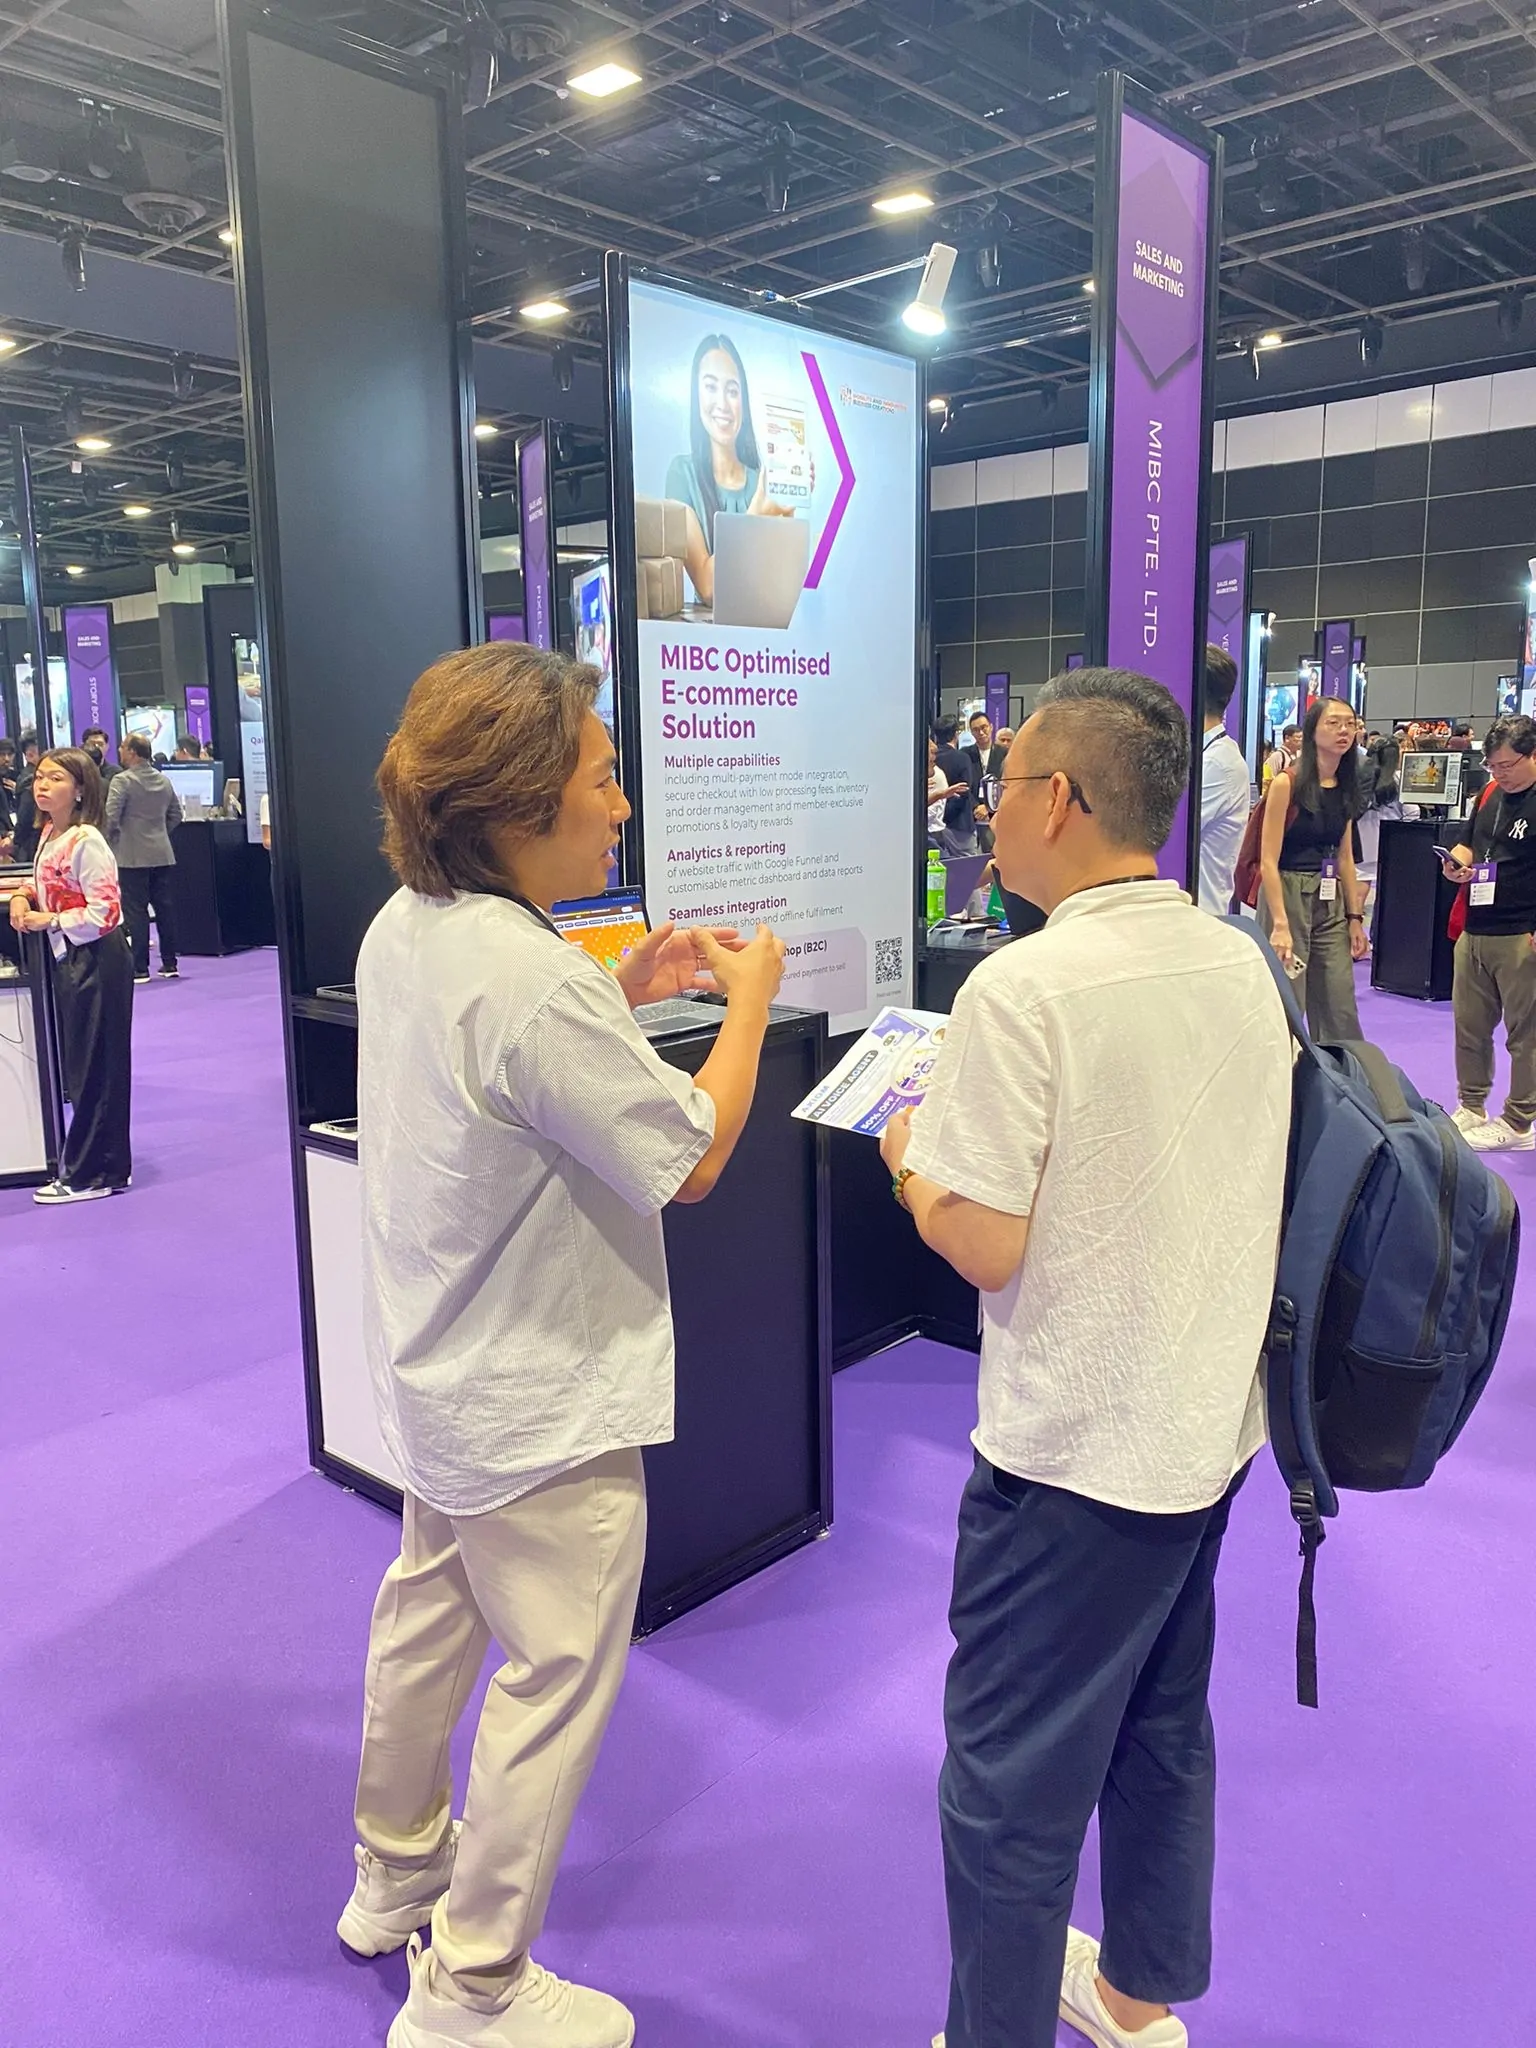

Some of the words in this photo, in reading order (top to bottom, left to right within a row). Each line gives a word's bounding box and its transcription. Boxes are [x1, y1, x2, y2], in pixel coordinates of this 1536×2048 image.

[1135, 240, 1162, 265] SALES
[1163, 254, 1183, 274] AND
[1132, 262, 1184, 297] MARKETING
[1147, 419, 1163, 504] MIBC
[1145, 513, 1160, 578] PTE.
[1143, 590, 1158, 655] LTD.
[661, 644, 719, 672] MIBC
[724, 647, 830, 679] Optimised
[661, 679, 798, 706] E-commerce
[662, 712, 755, 739] Solution
[664, 754, 714, 771] Multiple
[716, 753, 780, 770] capabilities
[664, 773, 710, 786] including
[712, 771, 777, 785] multi-payment
[779, 770, 803, 781] mode
[665, 791, 695, 801] secure
[697, 788, 737, 800] checkout
[739, 787, 758, 798] with
[760, 787, 774, 797] low
[775, 785, 817, 798] processing
[836, 783, 869, 795] inventory
[665, 806, 684, 817] and
[686, 805, 711, 816] order
[713, 803, 773, 816] management
[775, 800, 792, 811] and
[793, 798, 864, 810] member-exclusive
[666, 821, 720, 836] promotions
[722, 819, 729, 830] &
[730, 818, 758, 831] loyalty
[760, 816, 793, 828] rewards
[667, 845, 723, 862] Analytics
[725, 845, 732, 857] &
[735, 841, 786, 858] reporting
[667, 866, 677, 878] of
[679, 865, 714, 877] website
[716, 862, 742, 873] traffic
[744, 860, 763, 871] with
[764, 857, 794, 869] Google
[796, 854, 823, 866] Funnel
[824, 853, 839, 863] and
[668, 880, 727, 894] customisable
[729, 877, 757, 888] metric
[758, 871, 801, 885] dashboard
[803, 869, 817, 880] and
[819, 867, 835, 878] data
[837, 866, 863, 877] reports
[669, 904, 725, 920] Seamless
[727, 896, 787, 914] integration
[740, 916, 761, 927] shop
[763, 913, 778, 924] and
[780, 910, 805, 922] offline
[806, 905, 844, 918] fulfilment
[783, 945, 801, 957] hop
[803, 940, 827, 955] (B2C)
[801, 966, 828, 979] payment
[829, 965, 836, 973] to
[821, 1081, 850, 1109] VOICE
[860, 1111, 882, 1130] 50%
